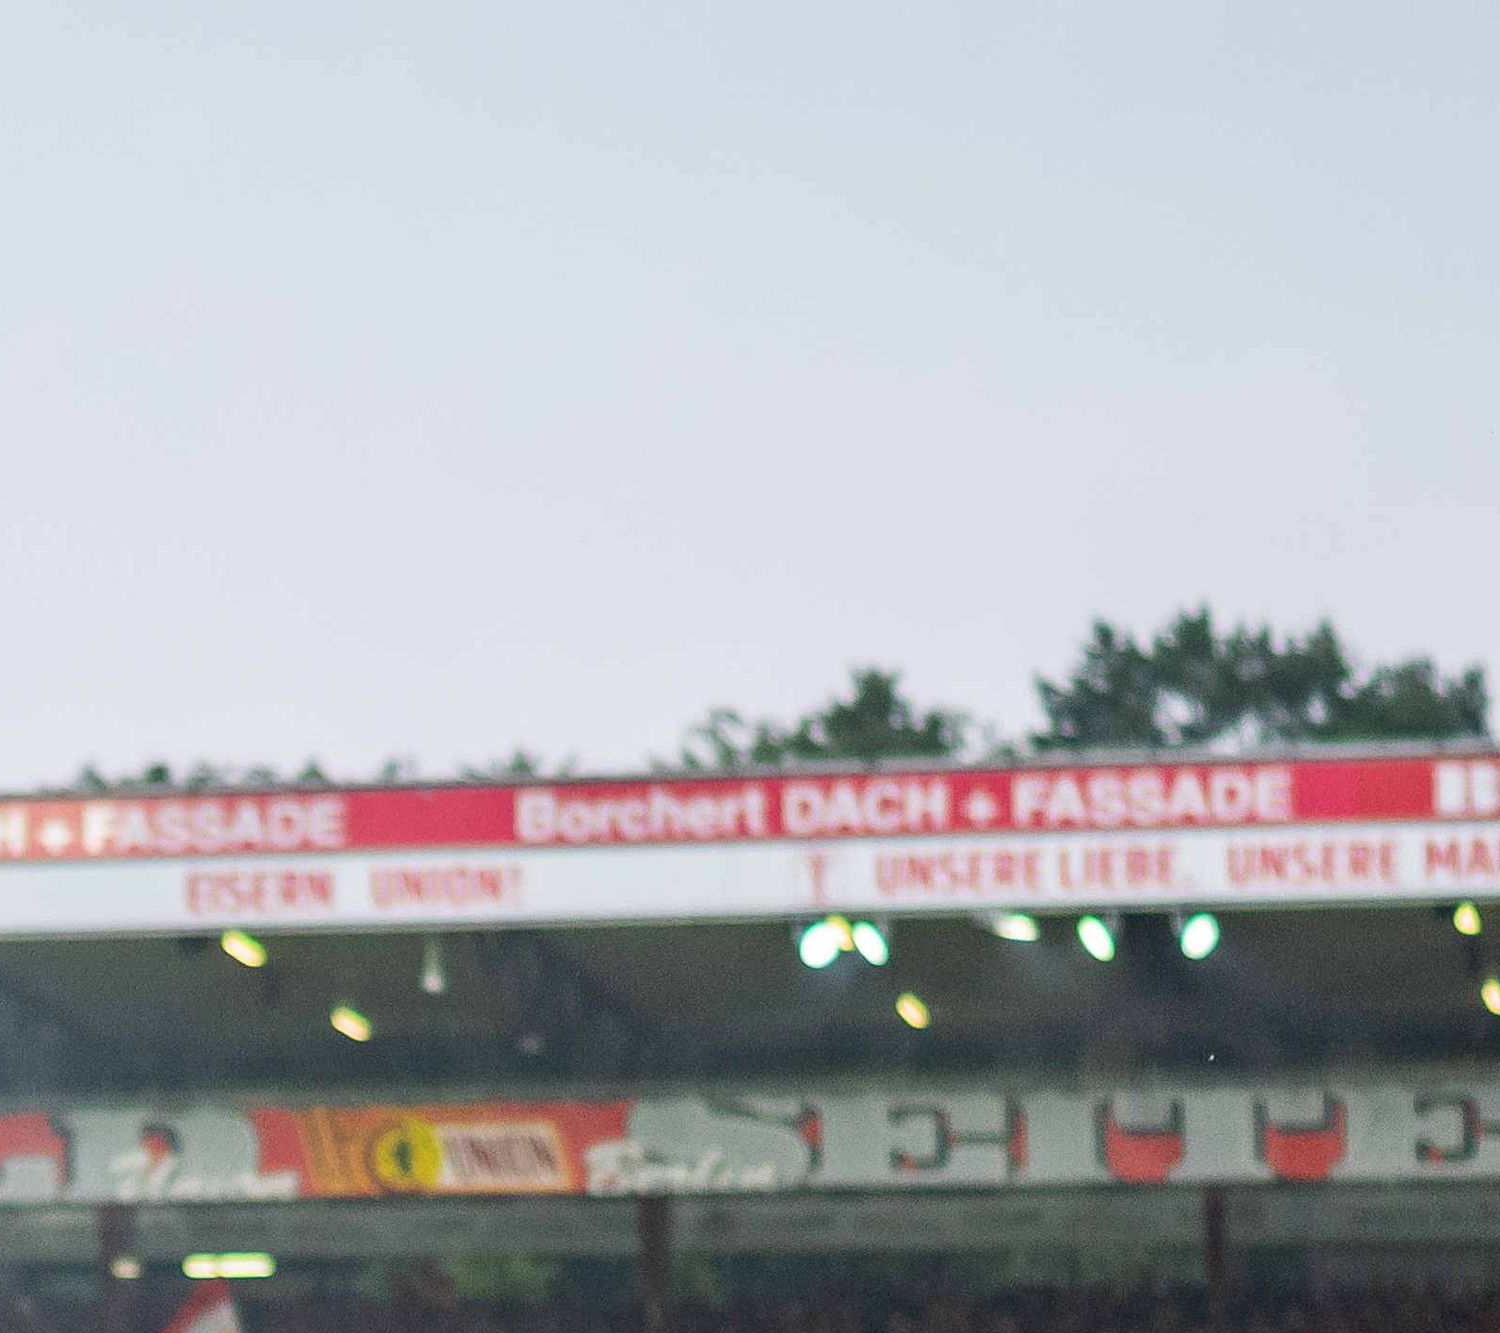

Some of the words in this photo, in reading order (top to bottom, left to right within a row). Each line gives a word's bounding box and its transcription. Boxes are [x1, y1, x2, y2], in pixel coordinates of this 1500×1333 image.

[82, 798, 344, 856] FASSADE
[785, 778, 947, 834] DACH
[1014, 768, 1292, 826] FASSADE
